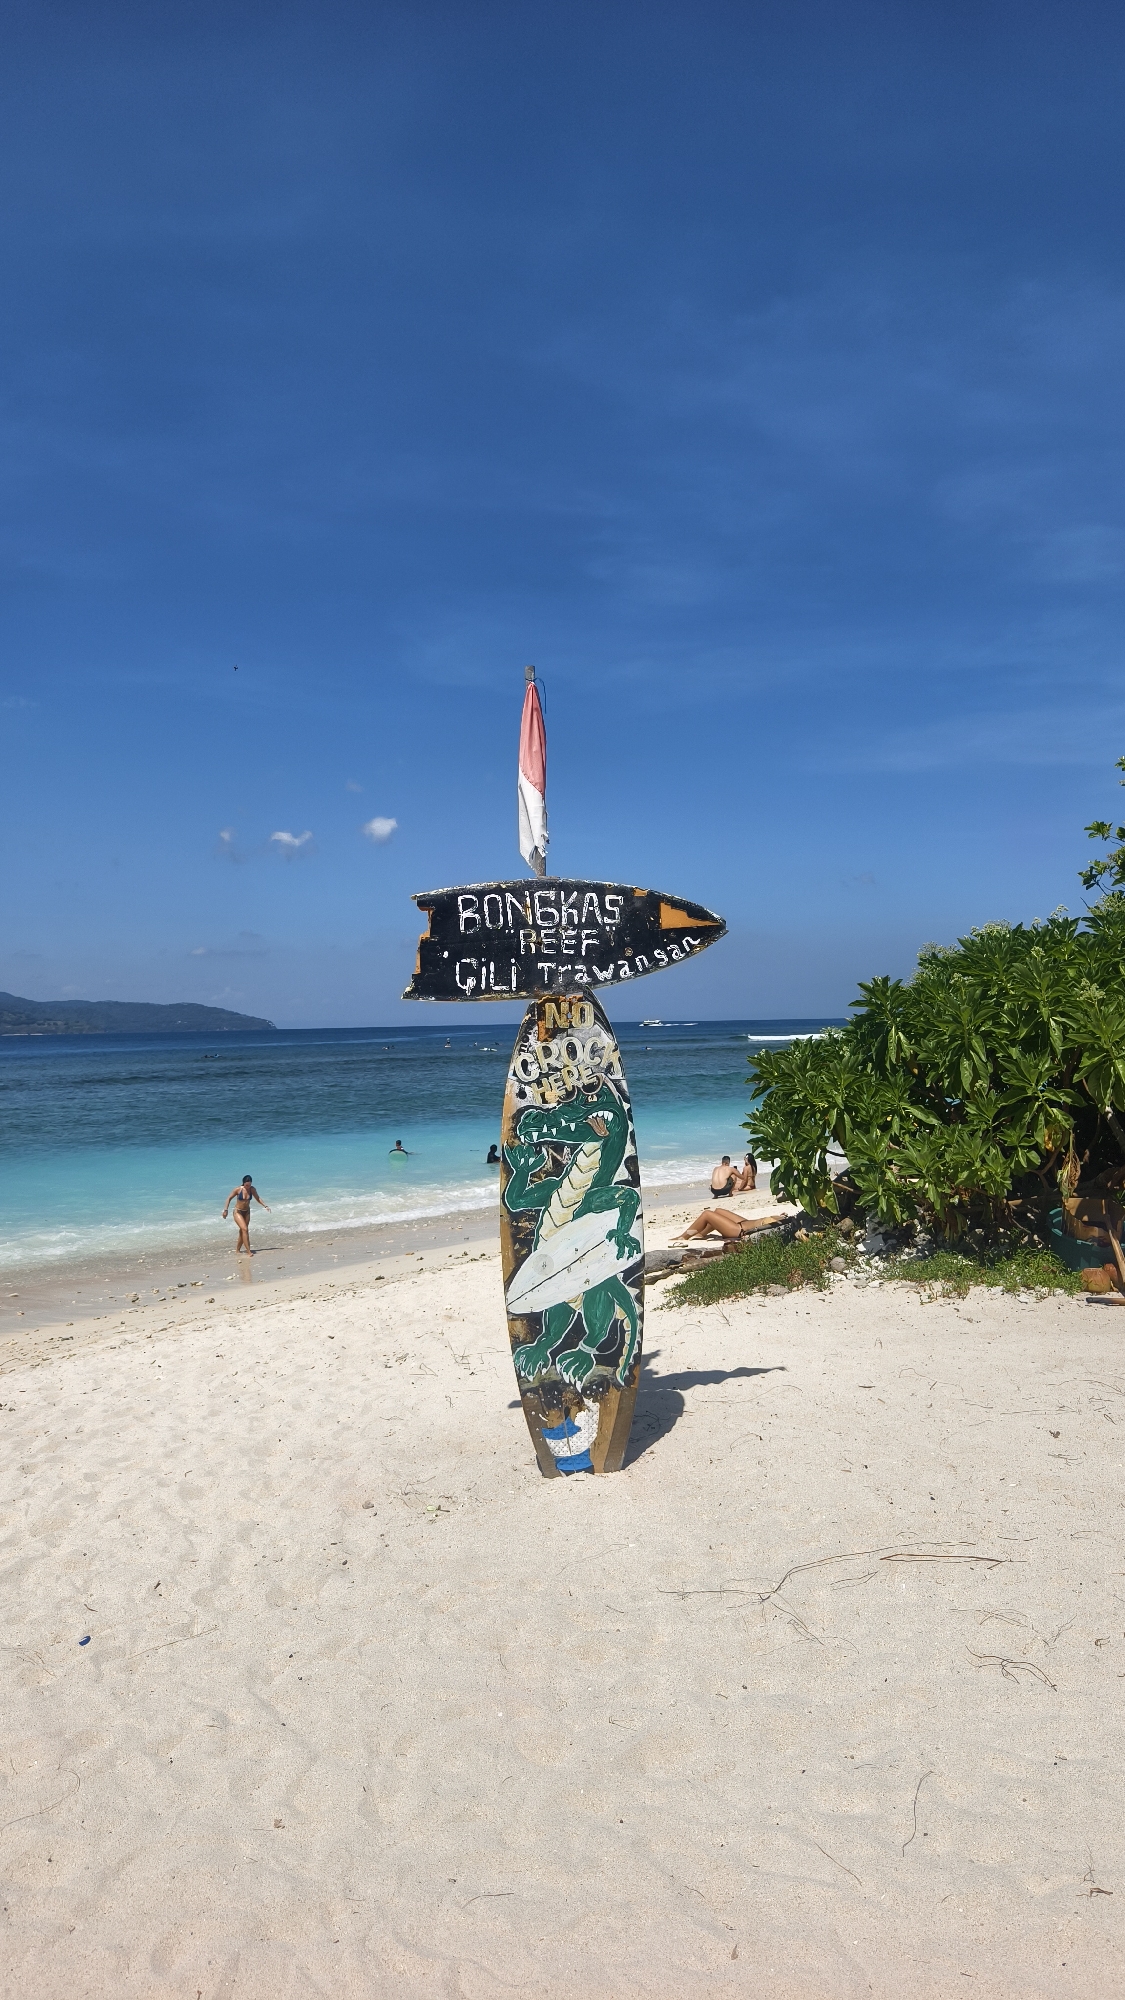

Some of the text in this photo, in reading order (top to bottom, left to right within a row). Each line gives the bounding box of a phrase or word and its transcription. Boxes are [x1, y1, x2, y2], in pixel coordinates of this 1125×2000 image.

[457, 890, 624, 934] BONGKAS
[544, 1001, 595, 1029] NO
[530, 1064, 598, 1105] HERE
